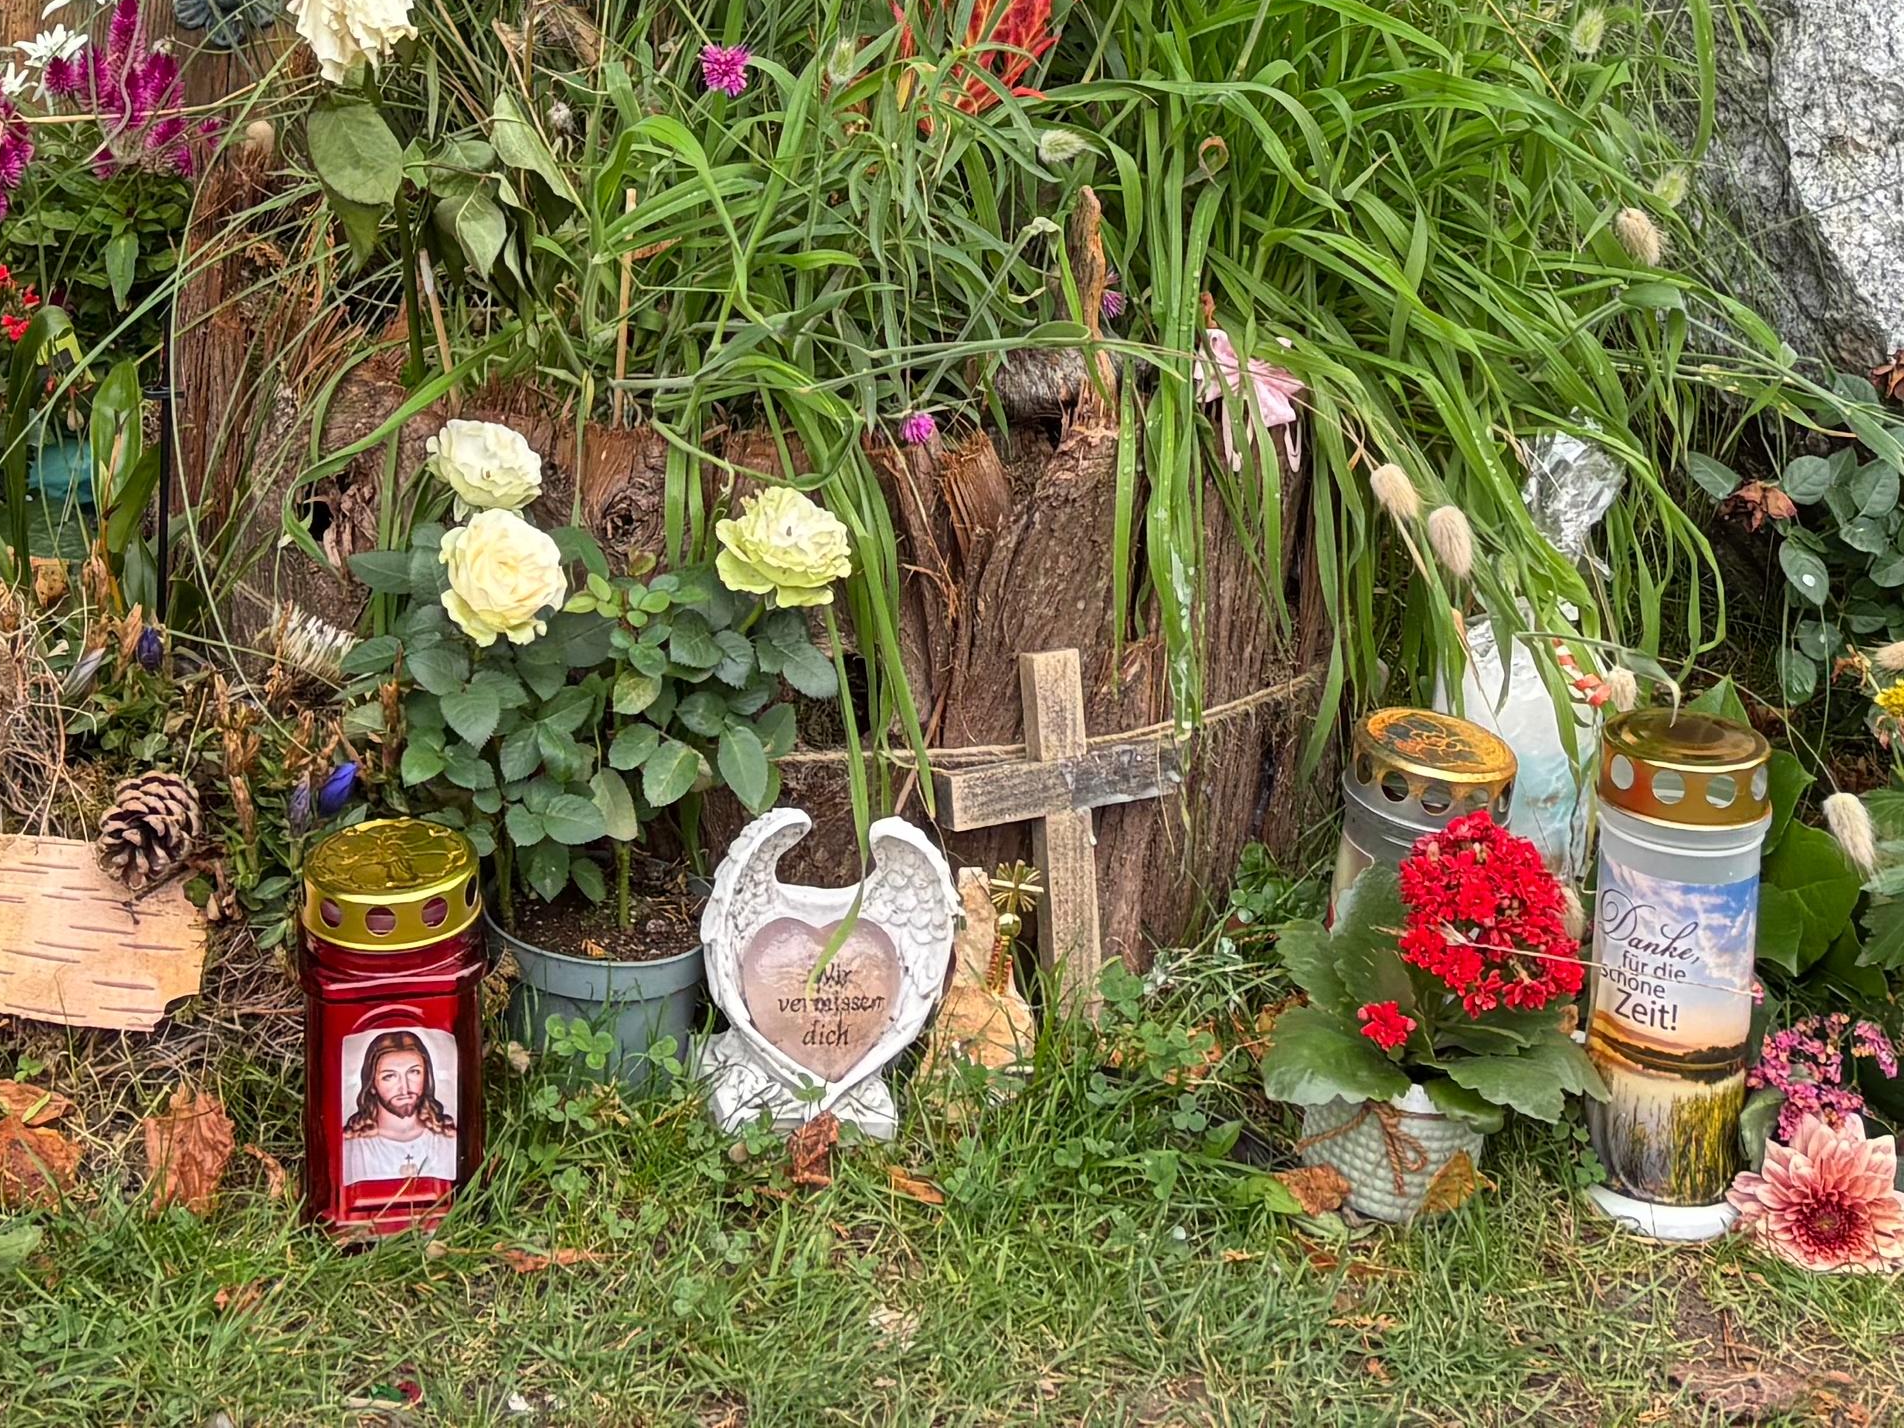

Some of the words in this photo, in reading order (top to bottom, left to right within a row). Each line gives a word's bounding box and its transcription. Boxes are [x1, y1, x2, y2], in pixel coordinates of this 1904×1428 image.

[1598, 888, 1702, 965] Danke,
[1622, 950, 1649, 974] für
[1653, 961, 1688, 984] die
[801, 1011, 851, 1047] dich
[1613, 987, 1680, 1032] Zeit!
